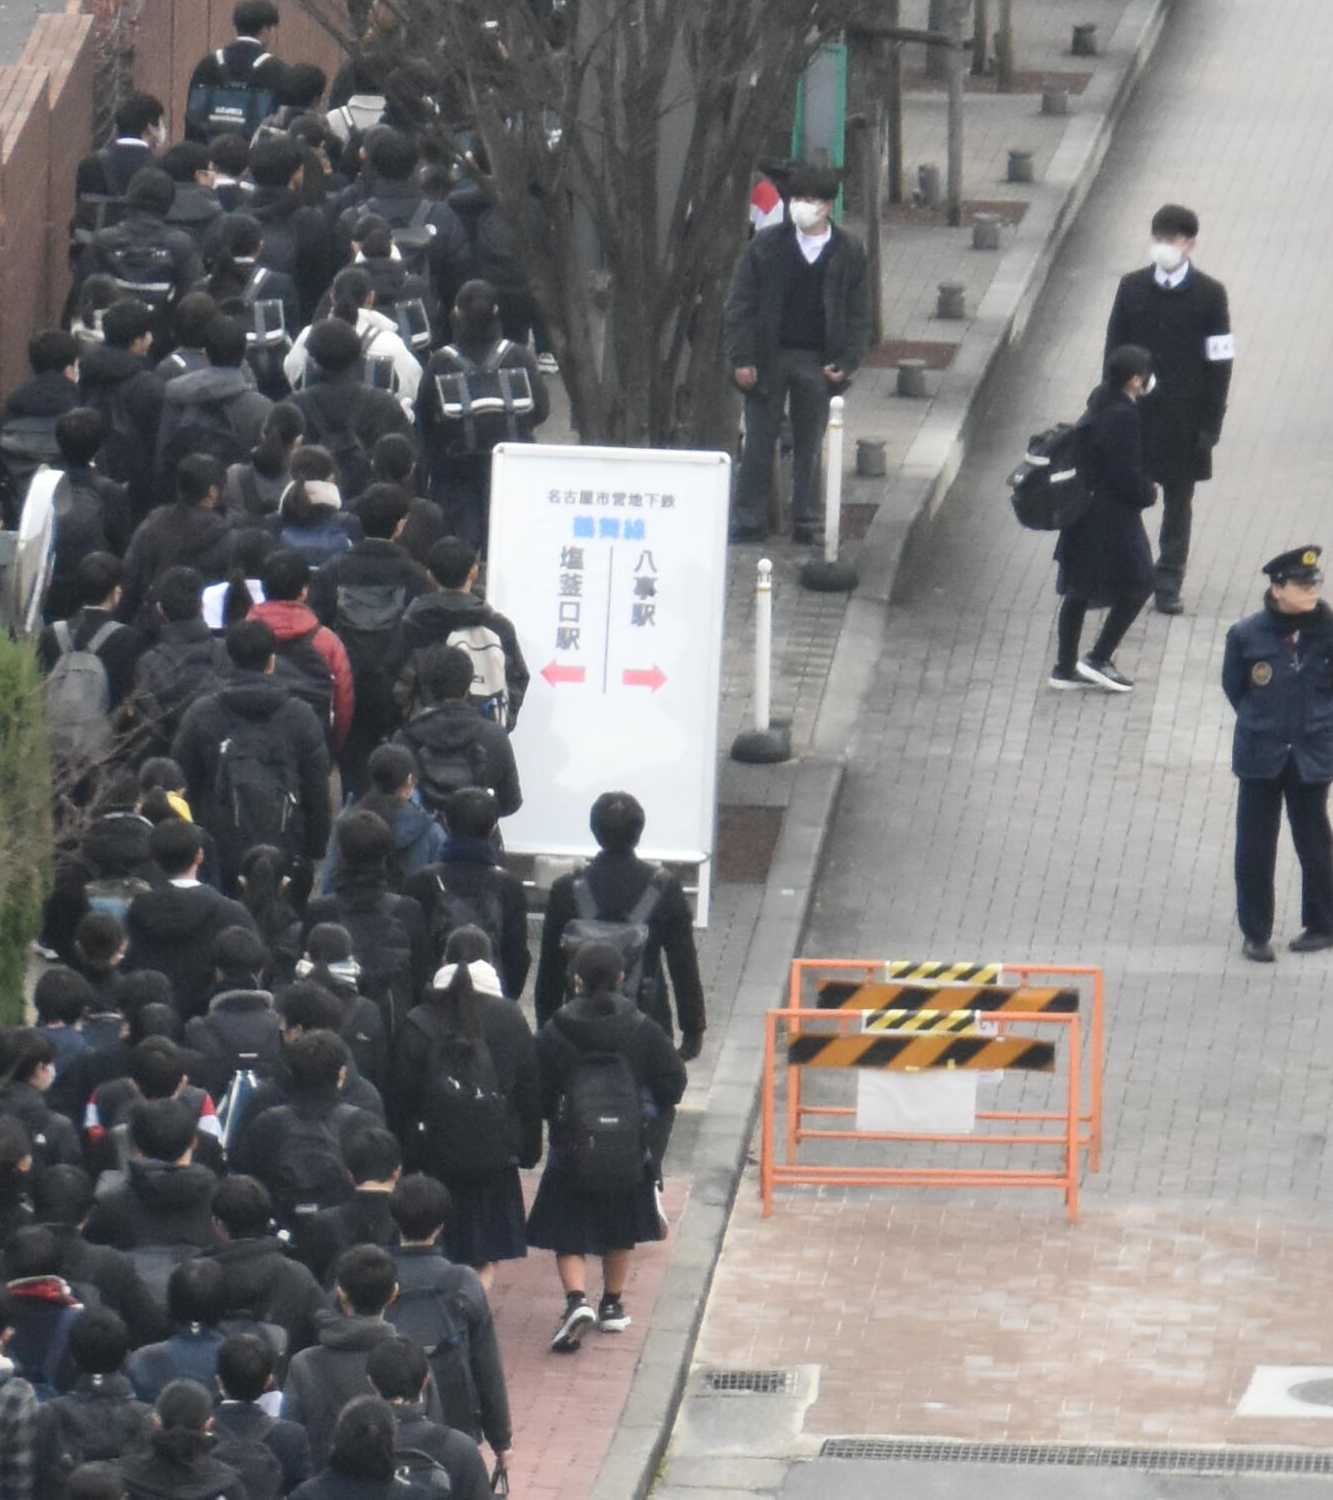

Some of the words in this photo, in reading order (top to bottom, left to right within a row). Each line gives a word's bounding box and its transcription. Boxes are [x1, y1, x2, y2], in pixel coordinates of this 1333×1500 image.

[548, 490, 675, 509] 名古屋市営地下鉄
[555, 545, 584, 650] 塩釜口駅
[631, 550, 658, 627] 八事駅
